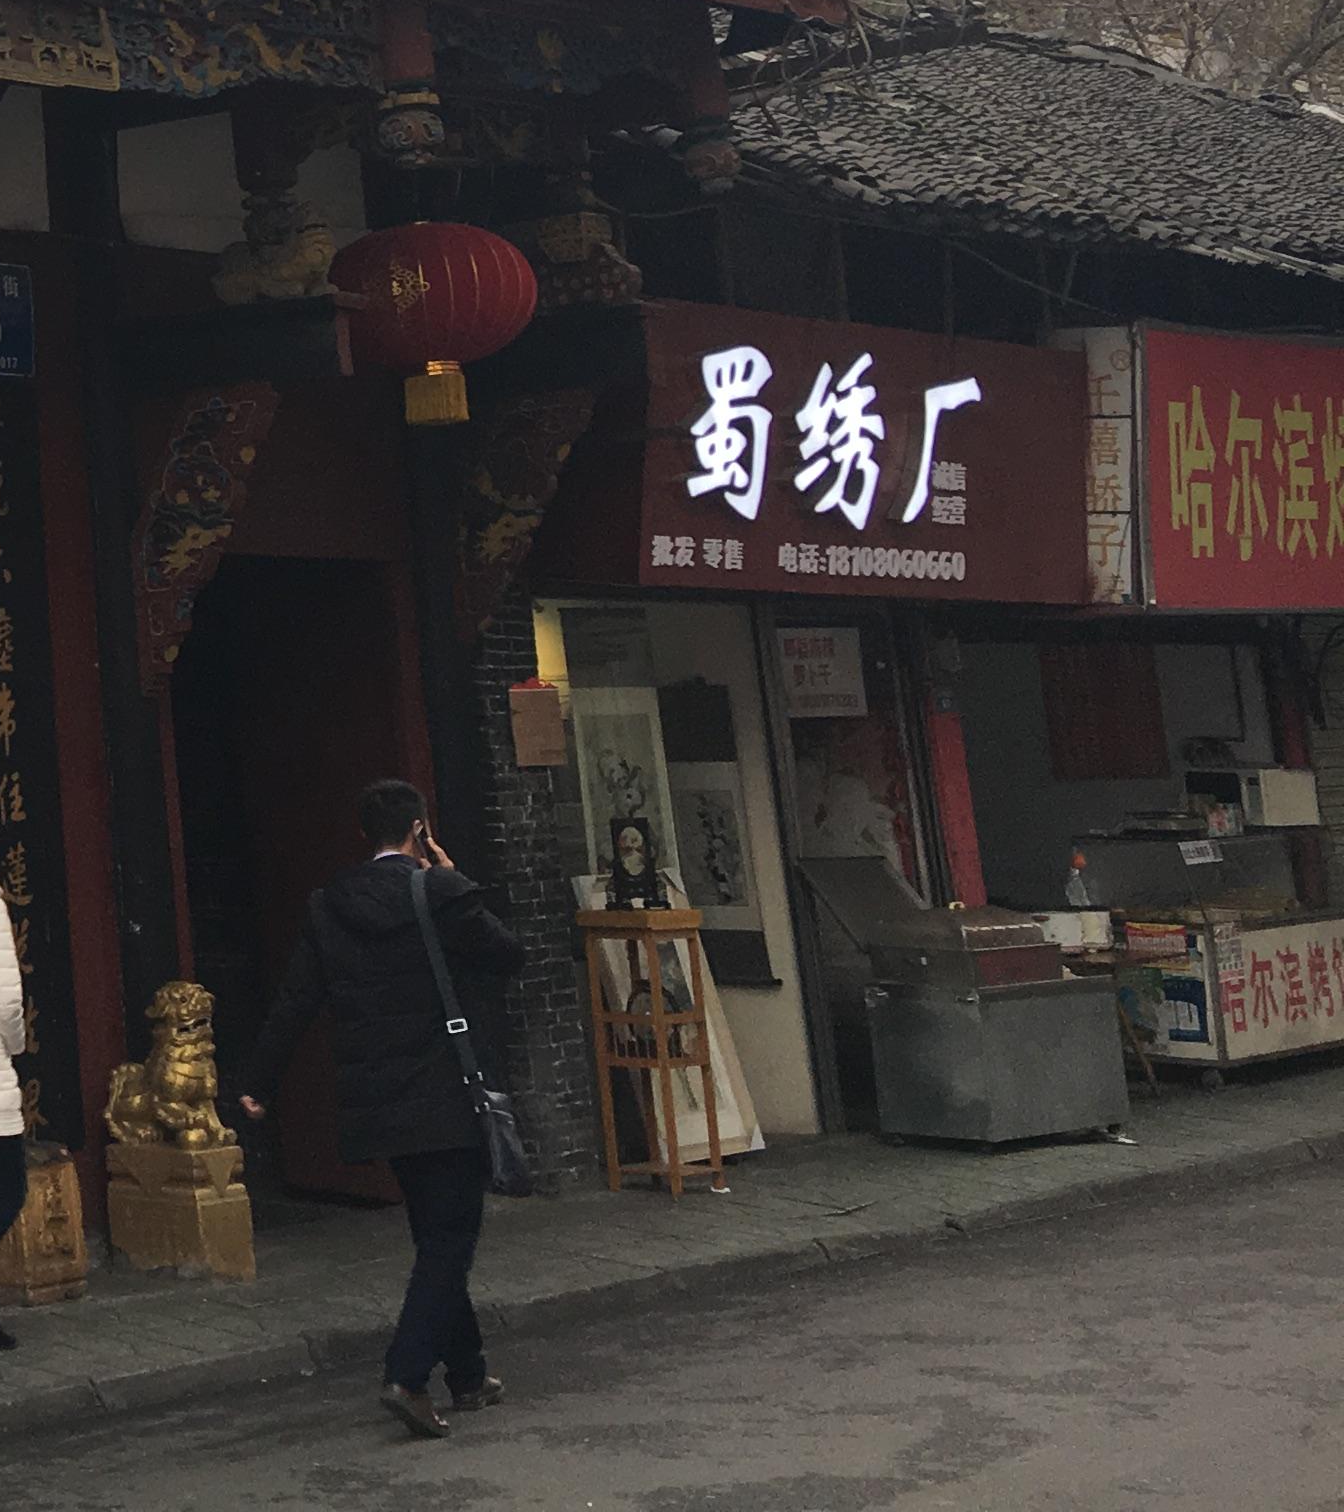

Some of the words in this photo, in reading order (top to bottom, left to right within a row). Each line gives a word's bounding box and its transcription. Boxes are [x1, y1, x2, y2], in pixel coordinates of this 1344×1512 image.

[686, 345, 982, 531] 蜀绣厂
[651, 534, 696, 567] 批发
[702, 538, 745, 570] 零售
